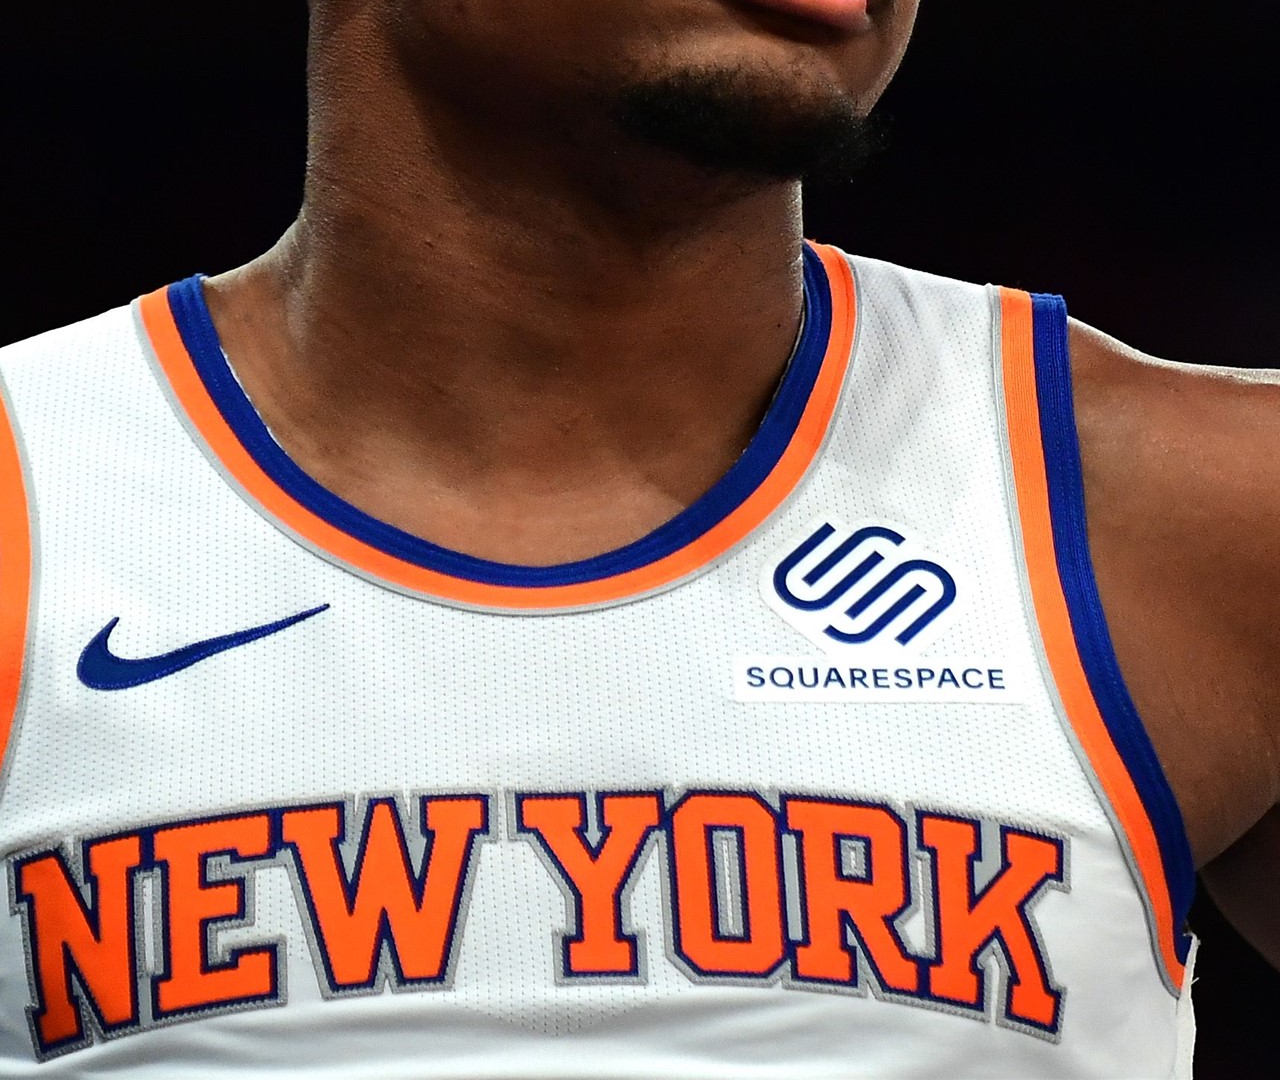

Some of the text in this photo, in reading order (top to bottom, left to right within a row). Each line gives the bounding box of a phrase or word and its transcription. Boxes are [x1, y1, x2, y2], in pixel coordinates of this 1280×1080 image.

[746, 666, 1006, 690] SQUARESPACE
[10, 786, 1071, 1060] NEW YORK
